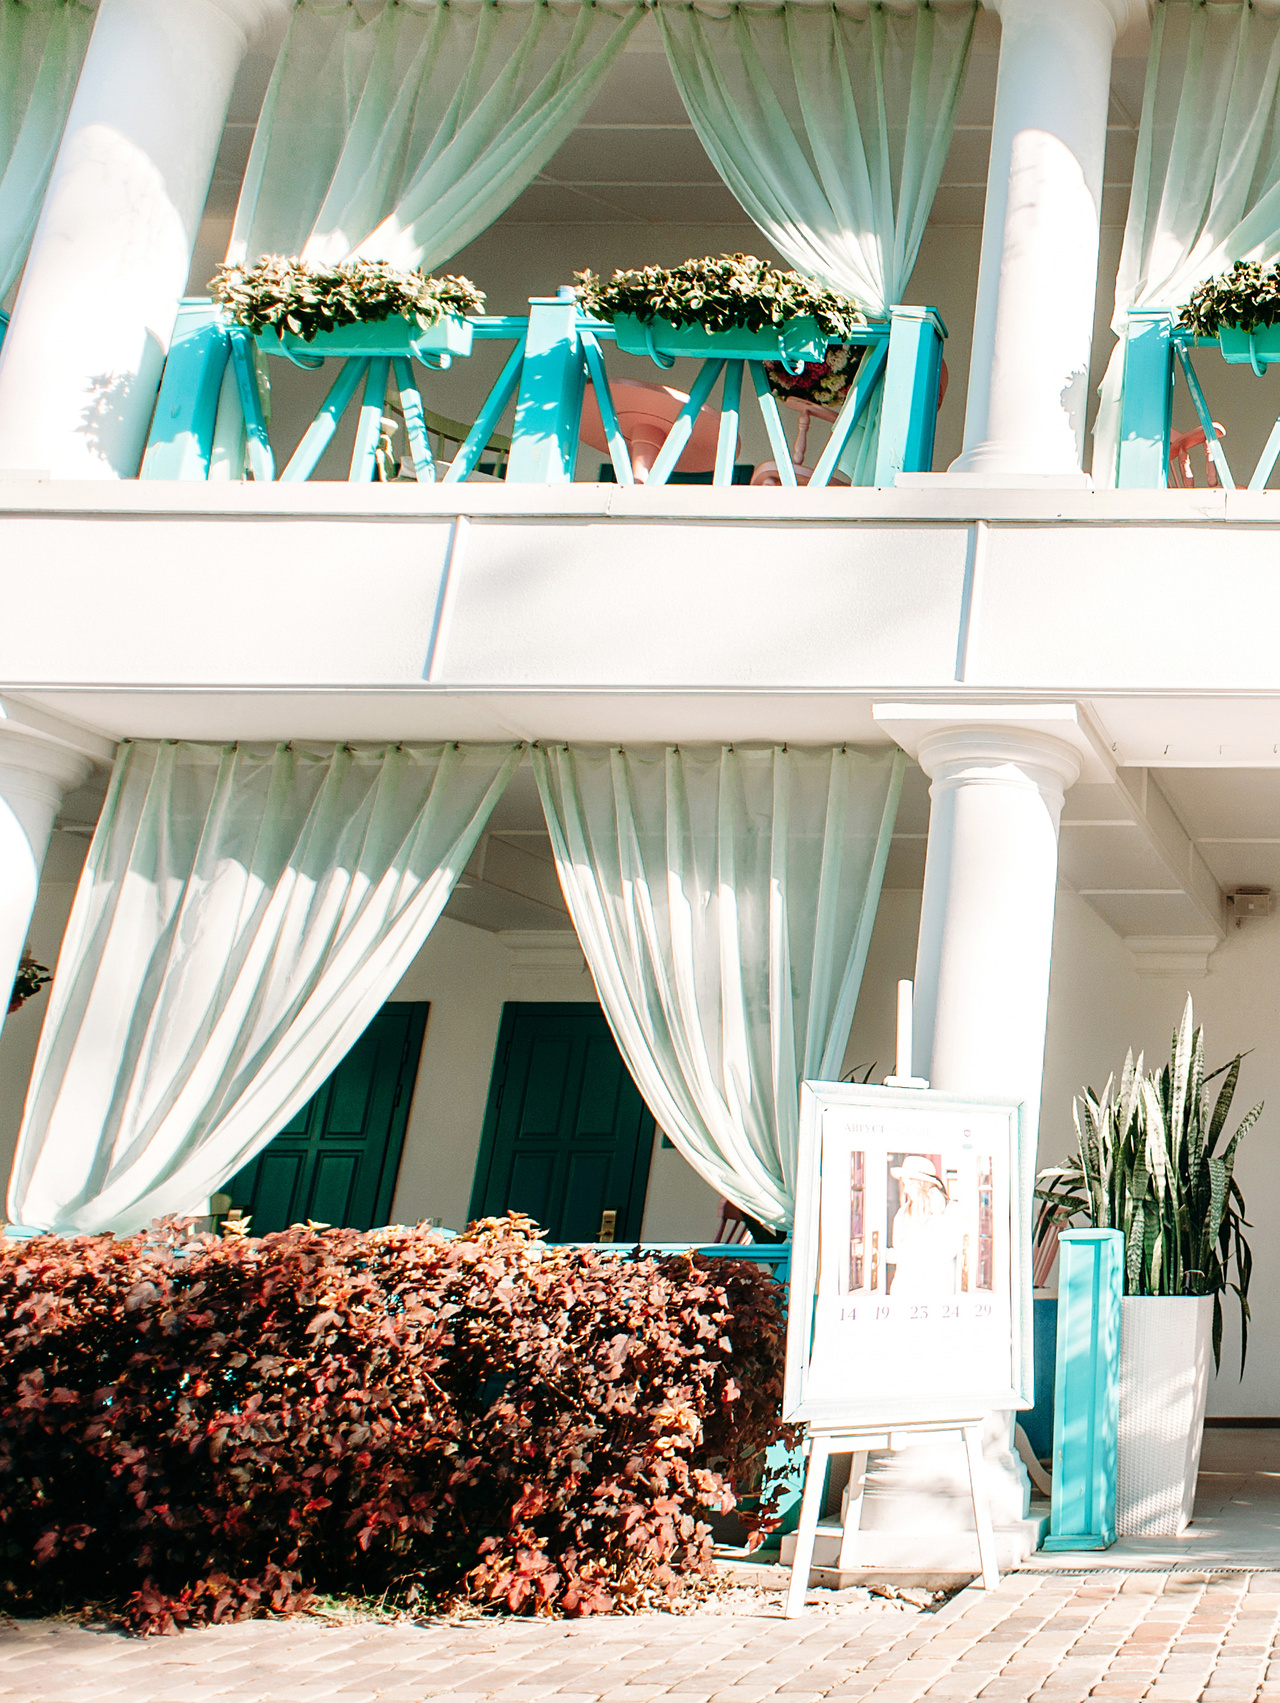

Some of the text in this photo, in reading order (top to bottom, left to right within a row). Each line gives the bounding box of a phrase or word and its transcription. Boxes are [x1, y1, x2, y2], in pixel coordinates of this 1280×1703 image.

[840, 1307, 857, 1321] 14
[875, 1306, 890, 1320] 19
[942, 1304, 960, 1318] 24
[974, 1303, 992, 1317] 29
